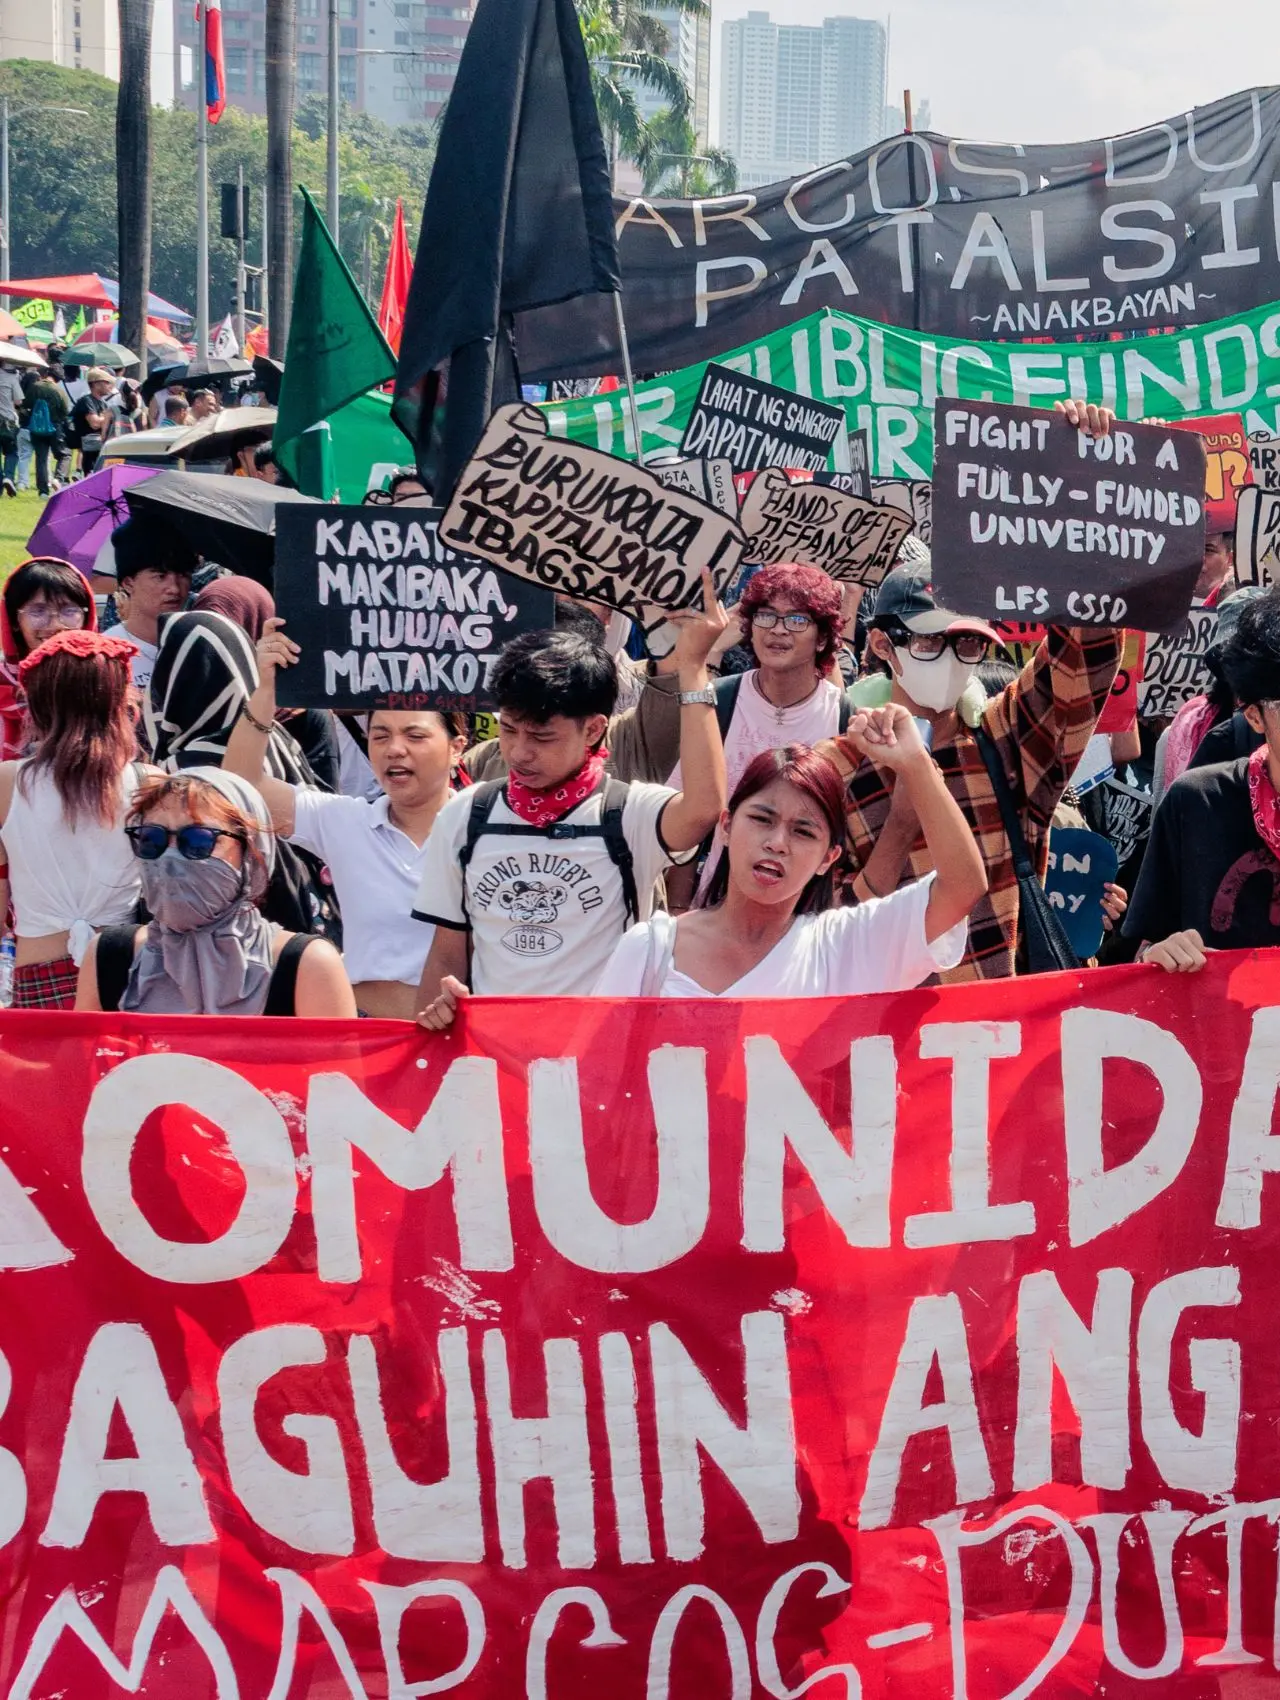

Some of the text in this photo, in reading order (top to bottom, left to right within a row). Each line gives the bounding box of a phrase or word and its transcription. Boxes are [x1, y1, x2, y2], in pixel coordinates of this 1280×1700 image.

[700, 374, 842, 443] LAHAT NG SANGKOT
[683, 409, 763, 470] DAPAT
[945, 410, 1179, 471] FIGHT FOR A
[472, 433, 704, 567] BURUKRATA
[760, 484, 846, 526] HANDS
[841, 506, 889, 538] OFF
[445, 499, 654, 621] IBAGSAK
[970, 511, 1166, 565] UNIVERSITY
[317, 561, 518, 622] MAKIBAKA,
[995, 585, 1128, 623] LFS CSSD
[350, 609, 493, 651] HUWAG
[323, 650, 501, 696] MATAKOT
[528, 852, 594, 890] RUGBY
[514, 933, 547, 951] 1984
[0, 1310, 802, 1570] AGUHIN
[857, 1264, 1244, 1531] ANG
